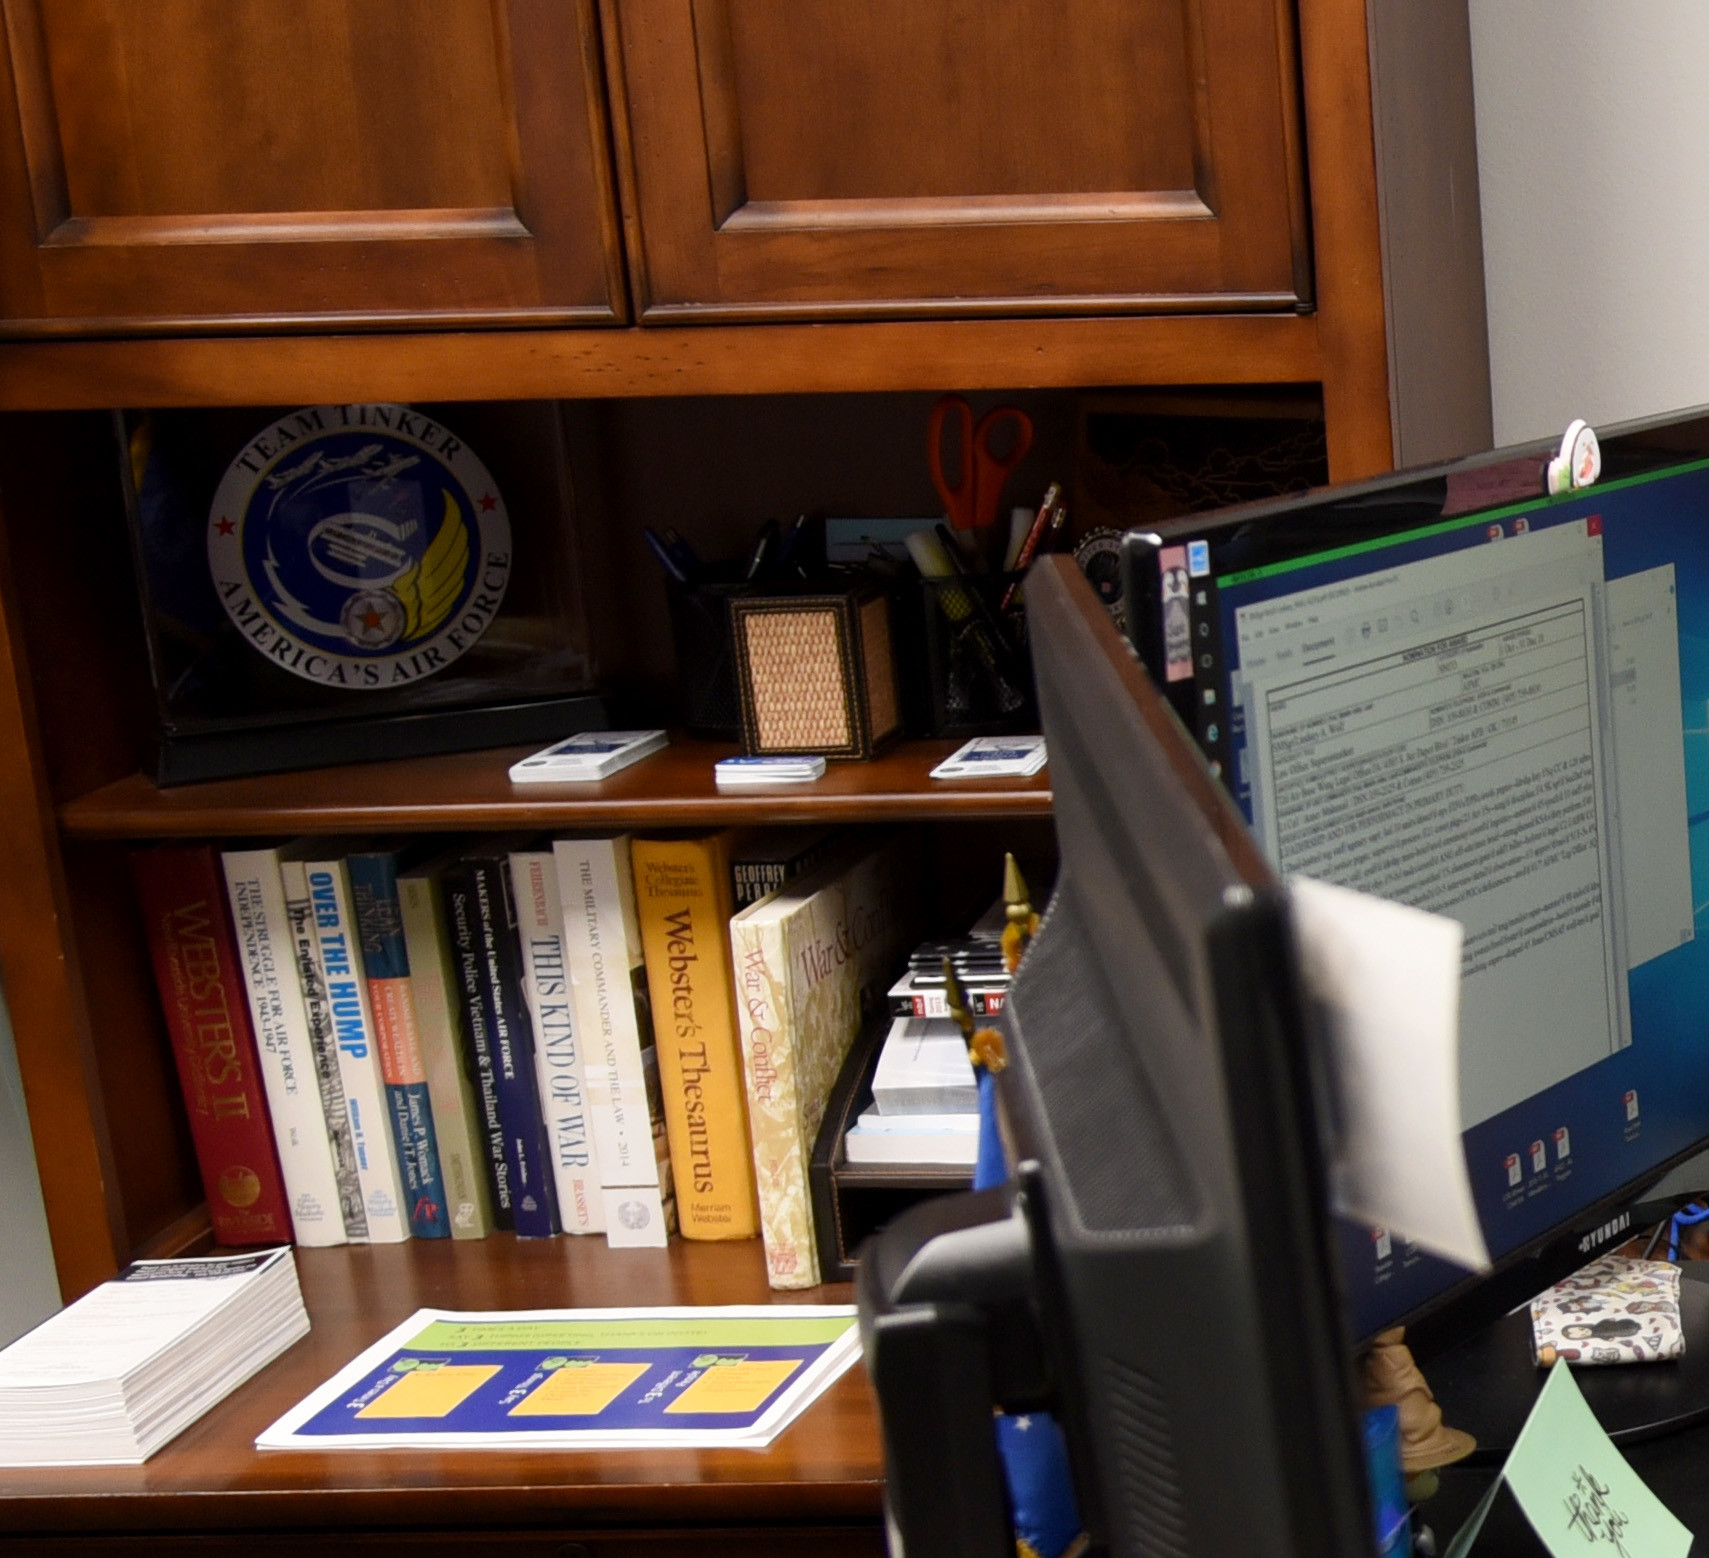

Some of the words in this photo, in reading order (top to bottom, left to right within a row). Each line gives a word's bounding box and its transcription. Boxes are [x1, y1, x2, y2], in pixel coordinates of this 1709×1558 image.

[236, 411, 325, 475] TEAM
[334, 405, 462, 462] TINKER
[219, 579, 380, 686] AMERICA'S
[392, 647, 447, 683] AIR
[447, 552, 509, 650] FORCE
[247, 878, 264, 909] THE
[579, 859, 593, 886] THE
[734, 865, 785, 883] GEOFFREY
[308, 870, 344, 930] OVER
[470, 870, 491, 921] MAKERS
[234, 880, 266, 991] INDEPENDENCE
[291, 907, 308, 935] The
[448, 892, 474, 952] Security
[479, 921, 493, 934] of
[583, 887, 601, 950] MILITARY
[253, 910, 278, 988] STRUGGLE
[319, 933, 353, 978] THE
[481, 933, 496, 949] the
[297, 937, 320, 999] Enlisted
[458, 951, 481, 995] Police
[484, 950, 502, 983] United
[530, 935, 565, 998] THIS
[665, 909, 698, 1038] Webster's
[744, 949, 764, 991] War
[173, 899, 243, 1089] WEBSTER'S
[267, 989, 284, 1019] FOR
[490, 983, 508, 1016] States
[592, 951, 612, 1038] COMMANDER
[748, 999, 764, 1022] &
[272, 1021, 289, 1048] AIR
[308, 1000, 334, 1080] Experience
[327, 980, 367, 1062] HUMP
[466, 995, 492, 1054] Vietnam
[493, 1016, 508, 1038] AIR
[539, 1003, 576, 1070] KIND
[277, 1049, 298, 1097] FORCE
[476, 1054, 494, 1067] &
[497, 1038, 516, 1081] FORCE
[604, 1039, 618, 1068] AND
[752, 1027, 775, 1102] Conflict
[392, 1090, 408, 1111] and
[479, 1068, 505, 1129] Thailand
[550, 1073, 581, 1108] OF
[608, 1070, 622, 1095] THE
[207, 1091, 250, 1125] II
[395, 1110, 414, 1146] Daniel
[406, 1091, 425, 1124] James
[612, 1097, 626, 1126] LAW
[678, 1041, 714, 1193] Thesaurus
[412, 1124, 428, 1138] P.
[490, 1131, 511, 1162] War
[556, 1115, 590, 1170] WAR
[404, 1158, 422, 1191] Jones
[414, 1138, 436, 1186] Womack
[495, 1161, 519, 1209] Stories
[1581, 1210, 1630, 1253] HYUNDAI
